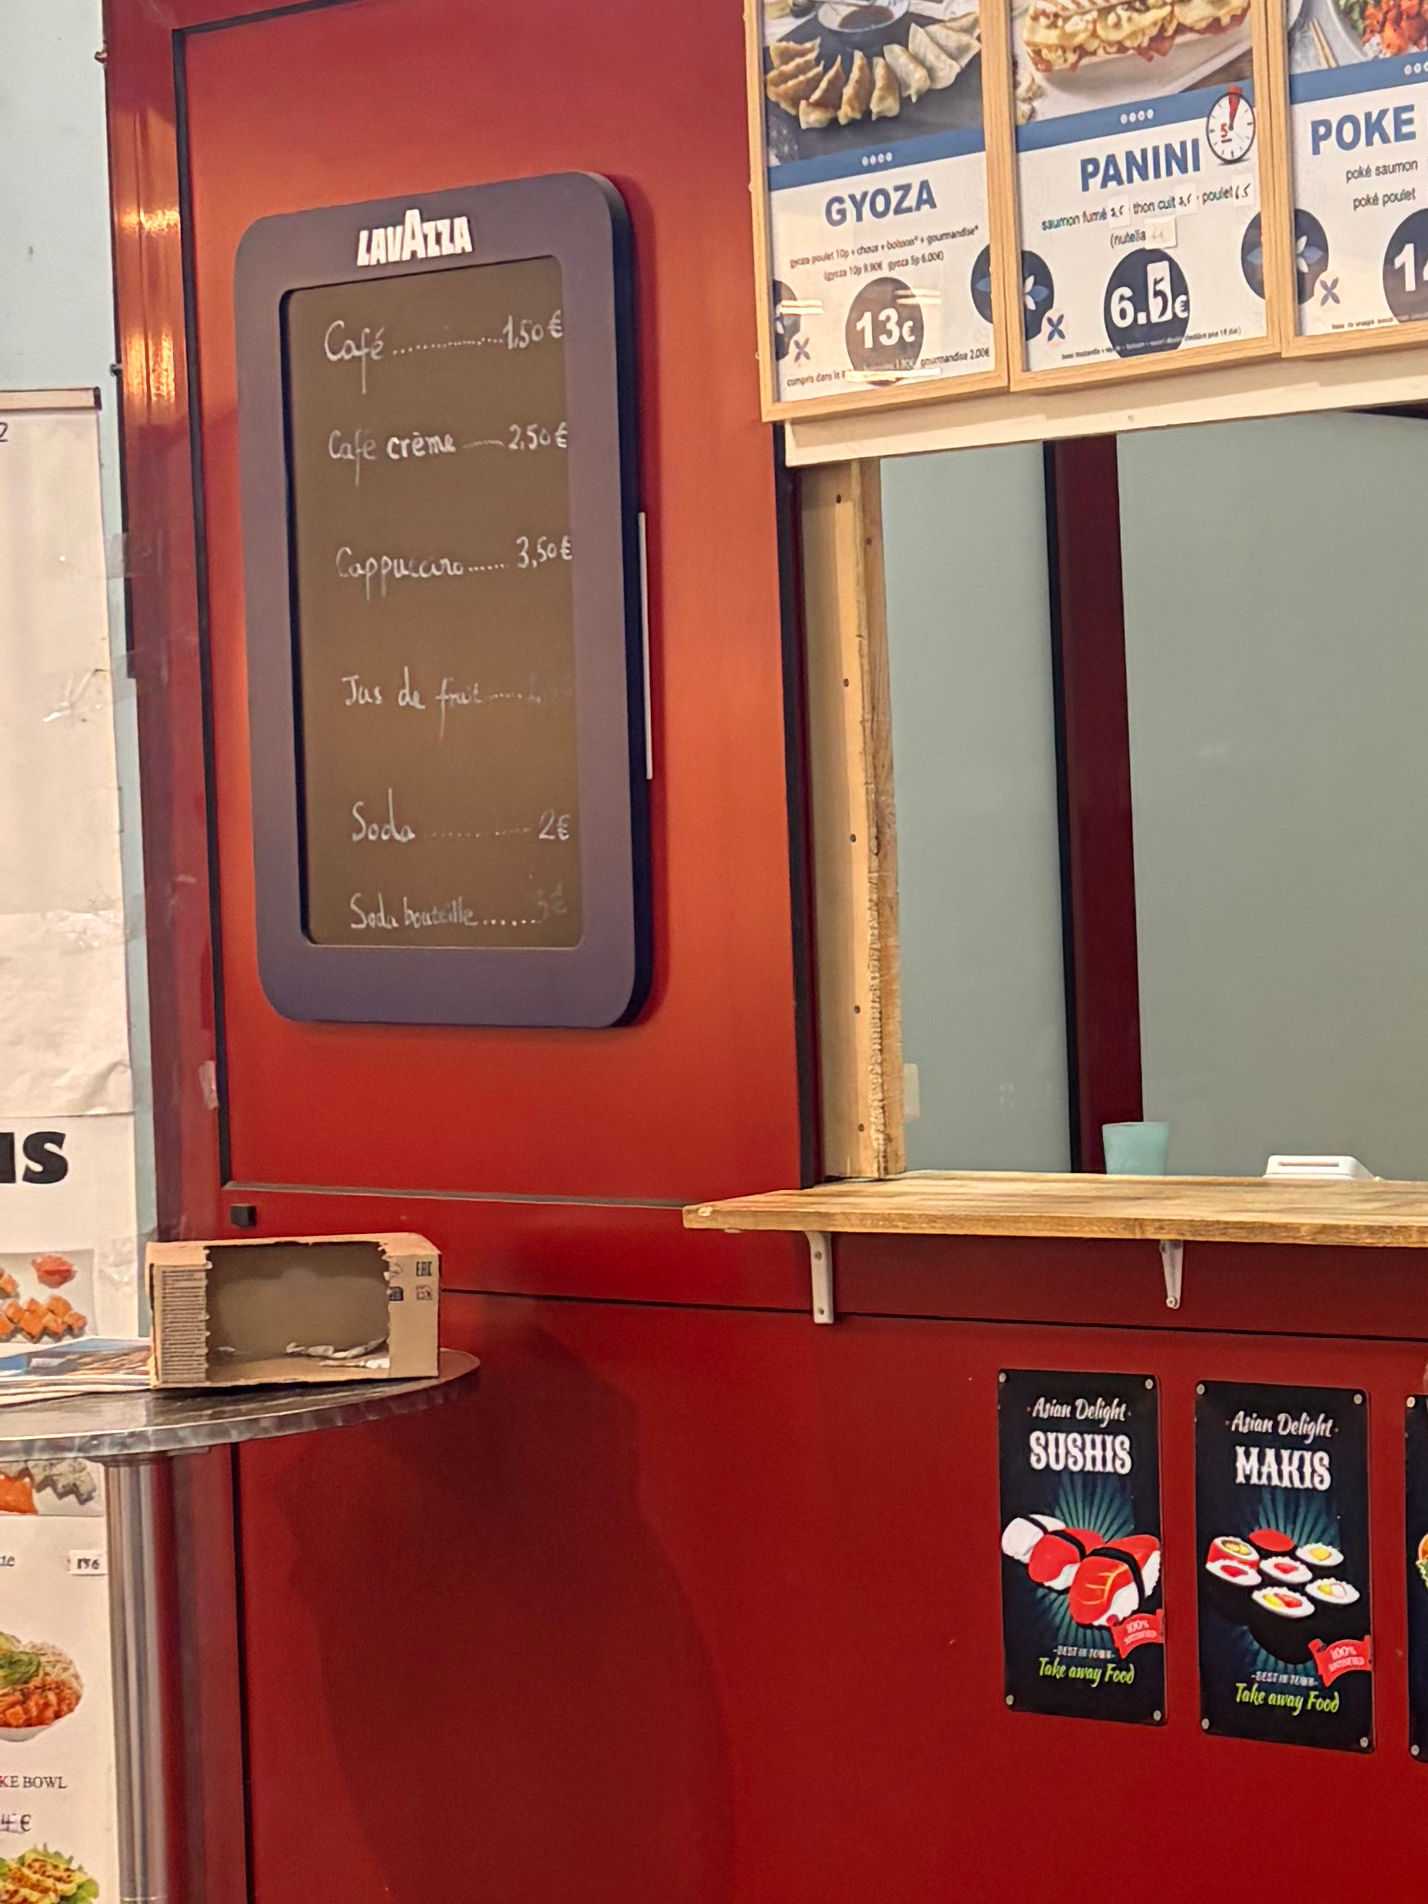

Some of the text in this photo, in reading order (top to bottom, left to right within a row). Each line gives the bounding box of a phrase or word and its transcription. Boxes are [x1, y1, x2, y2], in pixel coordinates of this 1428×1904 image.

[1311, 104, 1416, 156] POKE
[1080, 138, 1201, 192] PANINI
[1346, 165, 1372, 184] poké
[1375, 160, 1418, 177] saumon
[825, 179, 937, 228] GYOZA
[1353, 193, 1379, 211] poké
[1382, 188, 1416, 208] poulet
[356, 208, 473, 267] LAVAZZA
[856, 308, 916, 349] 13€
[324, 319, 385, 395] Café
[387, 433, 456, 460] crème
[341, 674, 382, 707] Jus
[398, 666, 425, 709] de
[351, 788, 415, 843] Soda
[350, 891, 478, 930] Soda bouteille
[1032, 1397, 1127, 1428] Asian Delight
[1231, 1410, 1333, 1444] Asian Delight
[1029, 1430, 1132, 1475] SUSHIS
[1235, 1446, 1331, 1491] MAKIS
[1235, 1683, 1340, 1713] Take Food
[22, 1775, 68, 1790] BOWL
